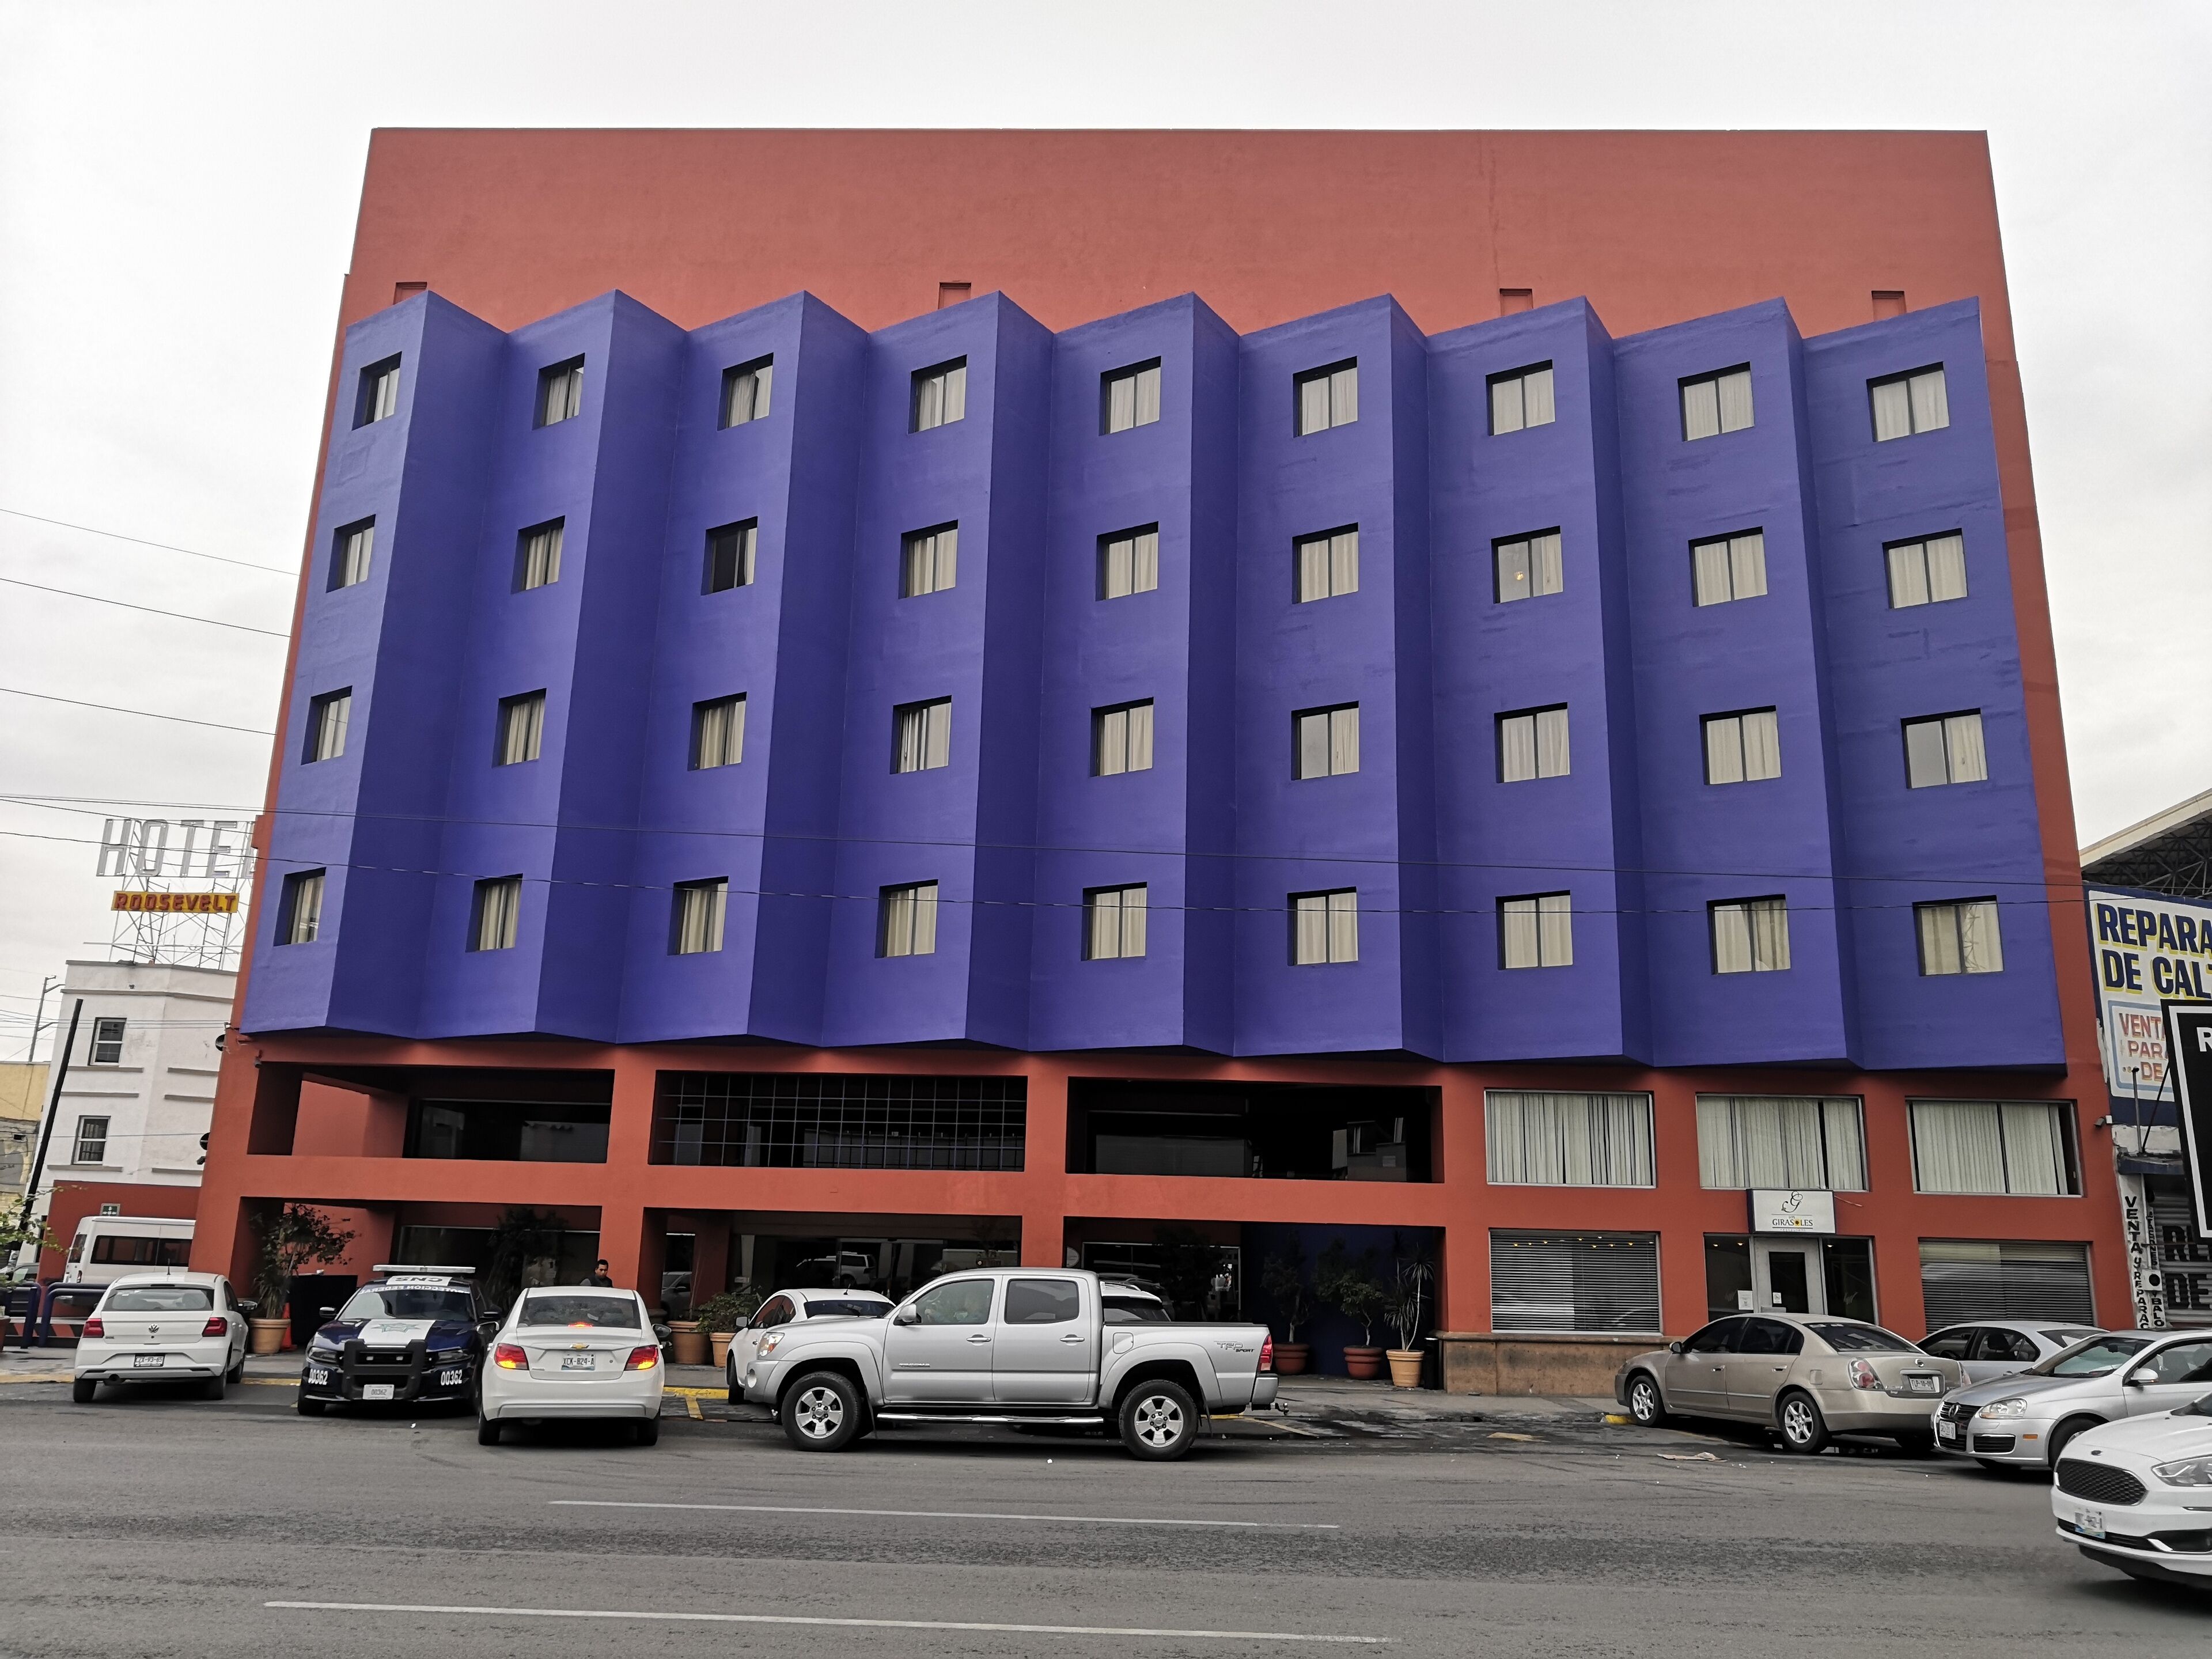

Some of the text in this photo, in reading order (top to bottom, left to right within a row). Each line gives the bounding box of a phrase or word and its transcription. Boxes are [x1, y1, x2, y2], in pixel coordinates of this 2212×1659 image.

[115, 892, 237, 912] ROOSEVELT
[2101, 949, 2212, 1000] DE CAL
[2127, 1040, 2168, 1060] PAR
[2140, 1061, 2164, 1082] DE
[1772, 1218, 1813, 1226] GIRASOLES
[2124, 1196, 2142, 1254] VENTA
[308, 1368, 328, 1385] 00362
[441, 1370, 463, 1386] 00362
